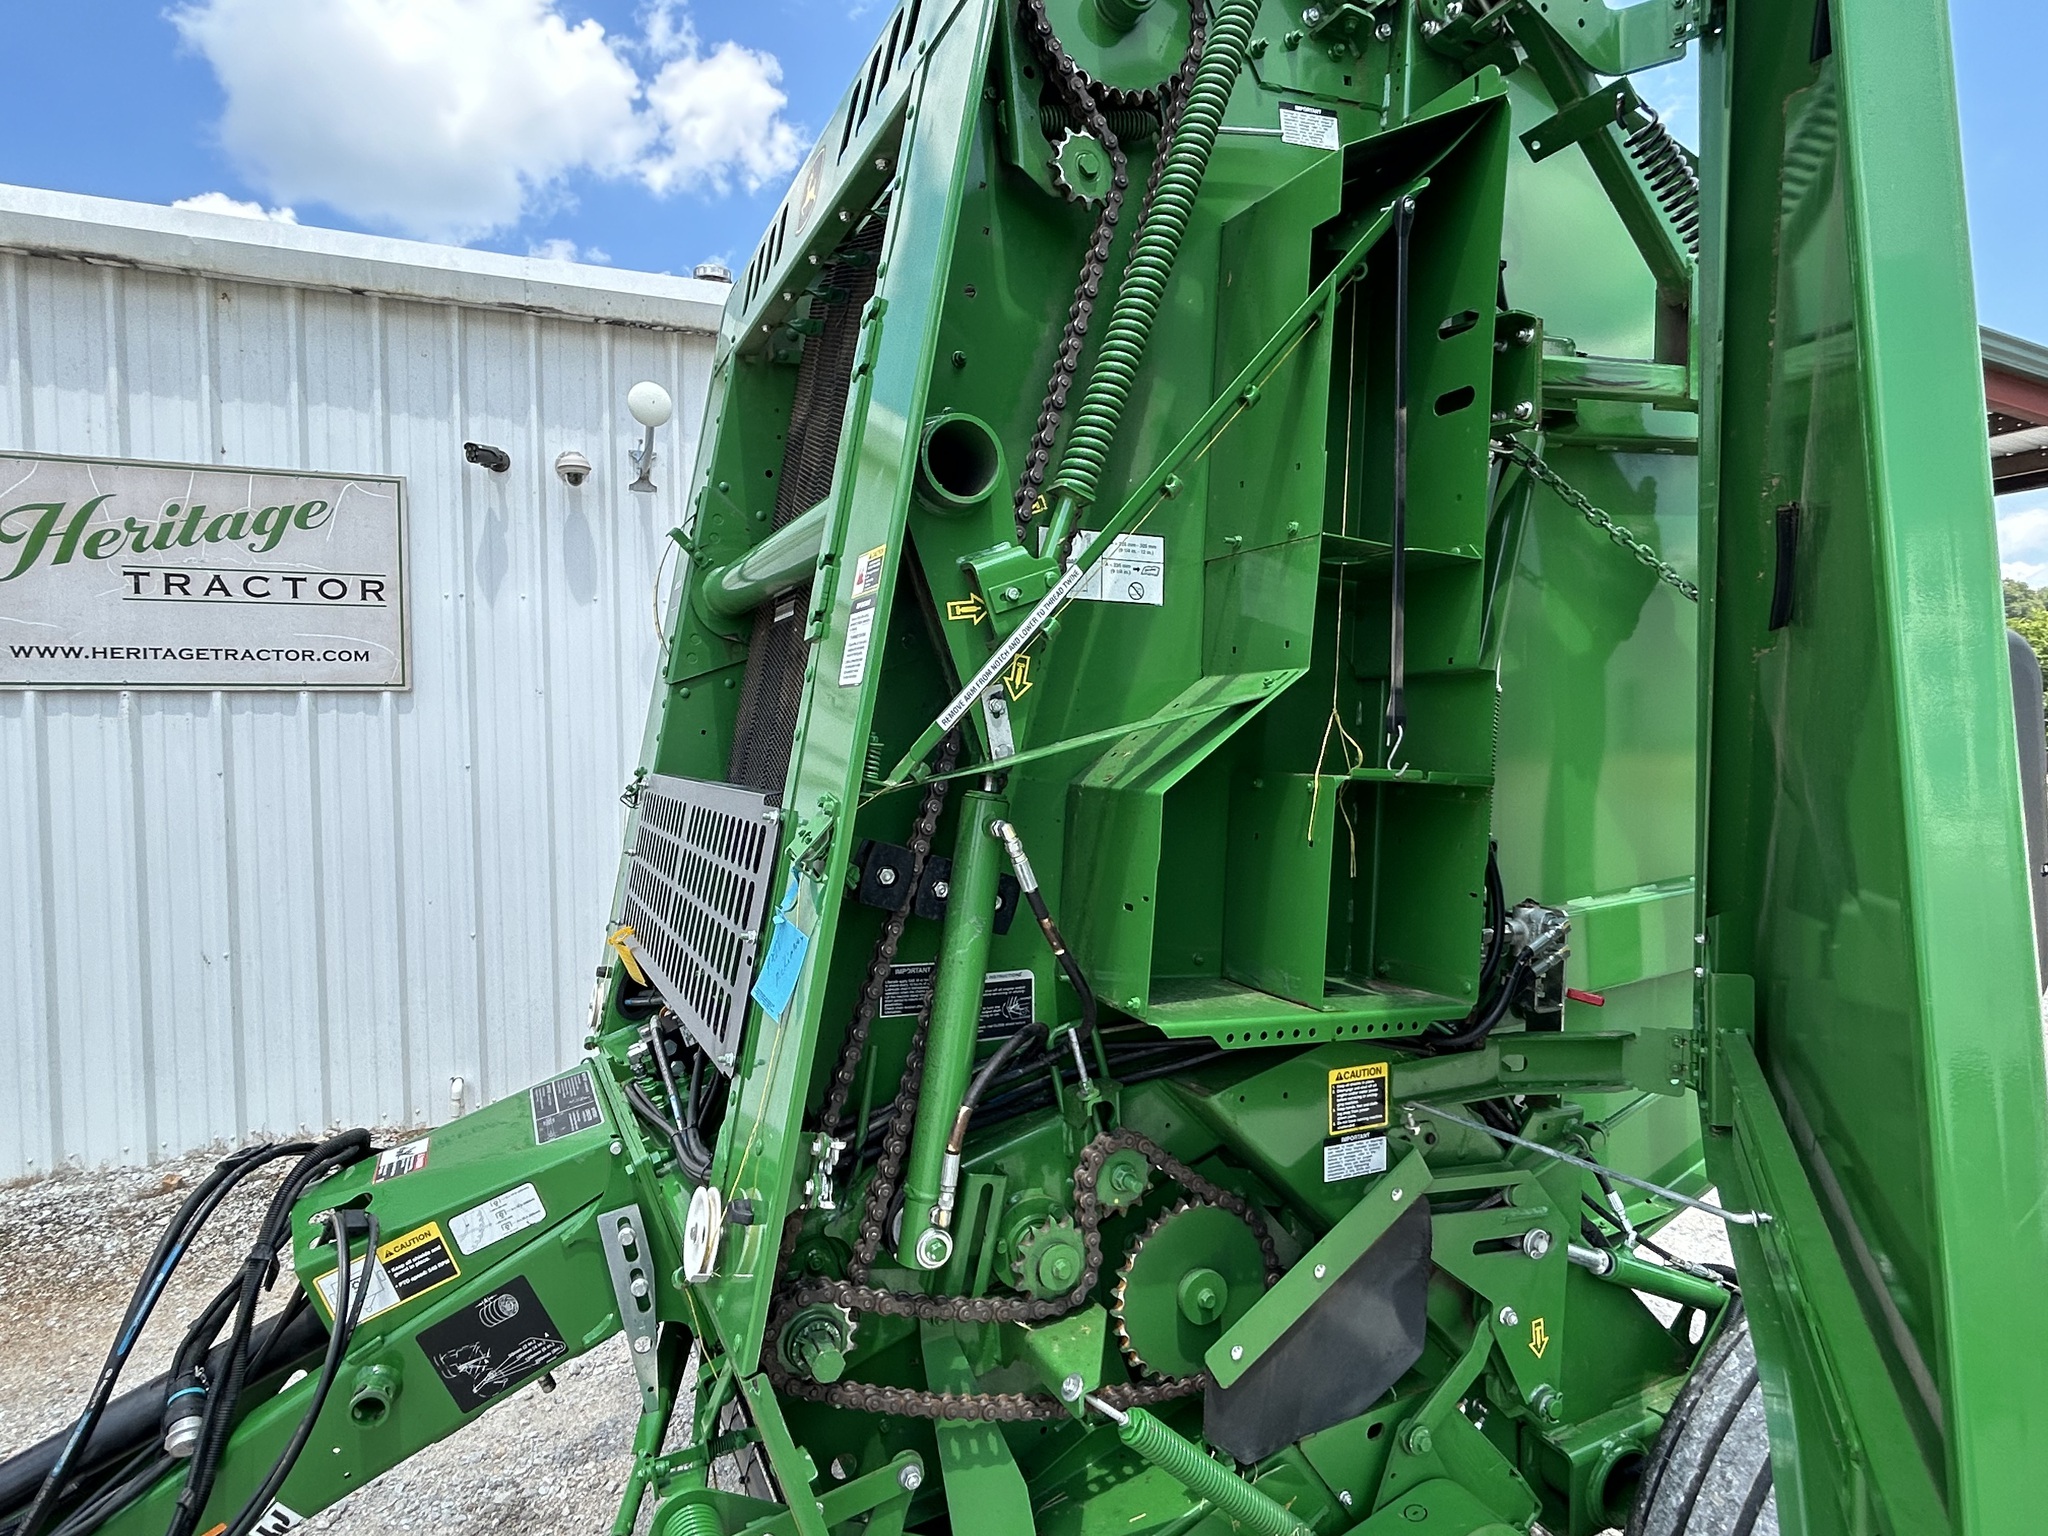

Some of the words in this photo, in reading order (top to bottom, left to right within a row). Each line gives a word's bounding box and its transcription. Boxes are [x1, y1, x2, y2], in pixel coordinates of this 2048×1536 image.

[0, 493, 335, 582] Heritage
[123, 570, 386, 601] TRACTOR
[9, 644, 370, 662] WWW.HERITAGETRACTOR.COM
[942, 700, 966, 726] REMOVE
[964, 686, 977, 702] ARM
[976, 670, 992, 690] FROM
[991, 650, 1010, 673] NOTCH
[1009, 637, 1021, 653] AND
[1020, 616, 1040, 639] LOWER
[1038, 609, 1047, 619] TO
[1045, 587, 1065, 611] THREAD
[1063, 569, 1080, 589] TWINE
[895, 967, 931, 975] IMPORTANT
[1343, 1066, 1382, 1080] CAUTION
[1341, 1132, 1370, 1142] IMPORTANT
[393, 1230, 432, 1253] CAUTION
[391, 1262, 405, 1272] Keep
[412, 1250, 431, 1262] shields
[431, 1244, 442, 1253] and
[415, 1256, 431, 1267] place.
[398, 1277, 410, 1287] PTO
[428, 1264, 438, 1273] 540
[438, 1258, 450, 1268] RPM
